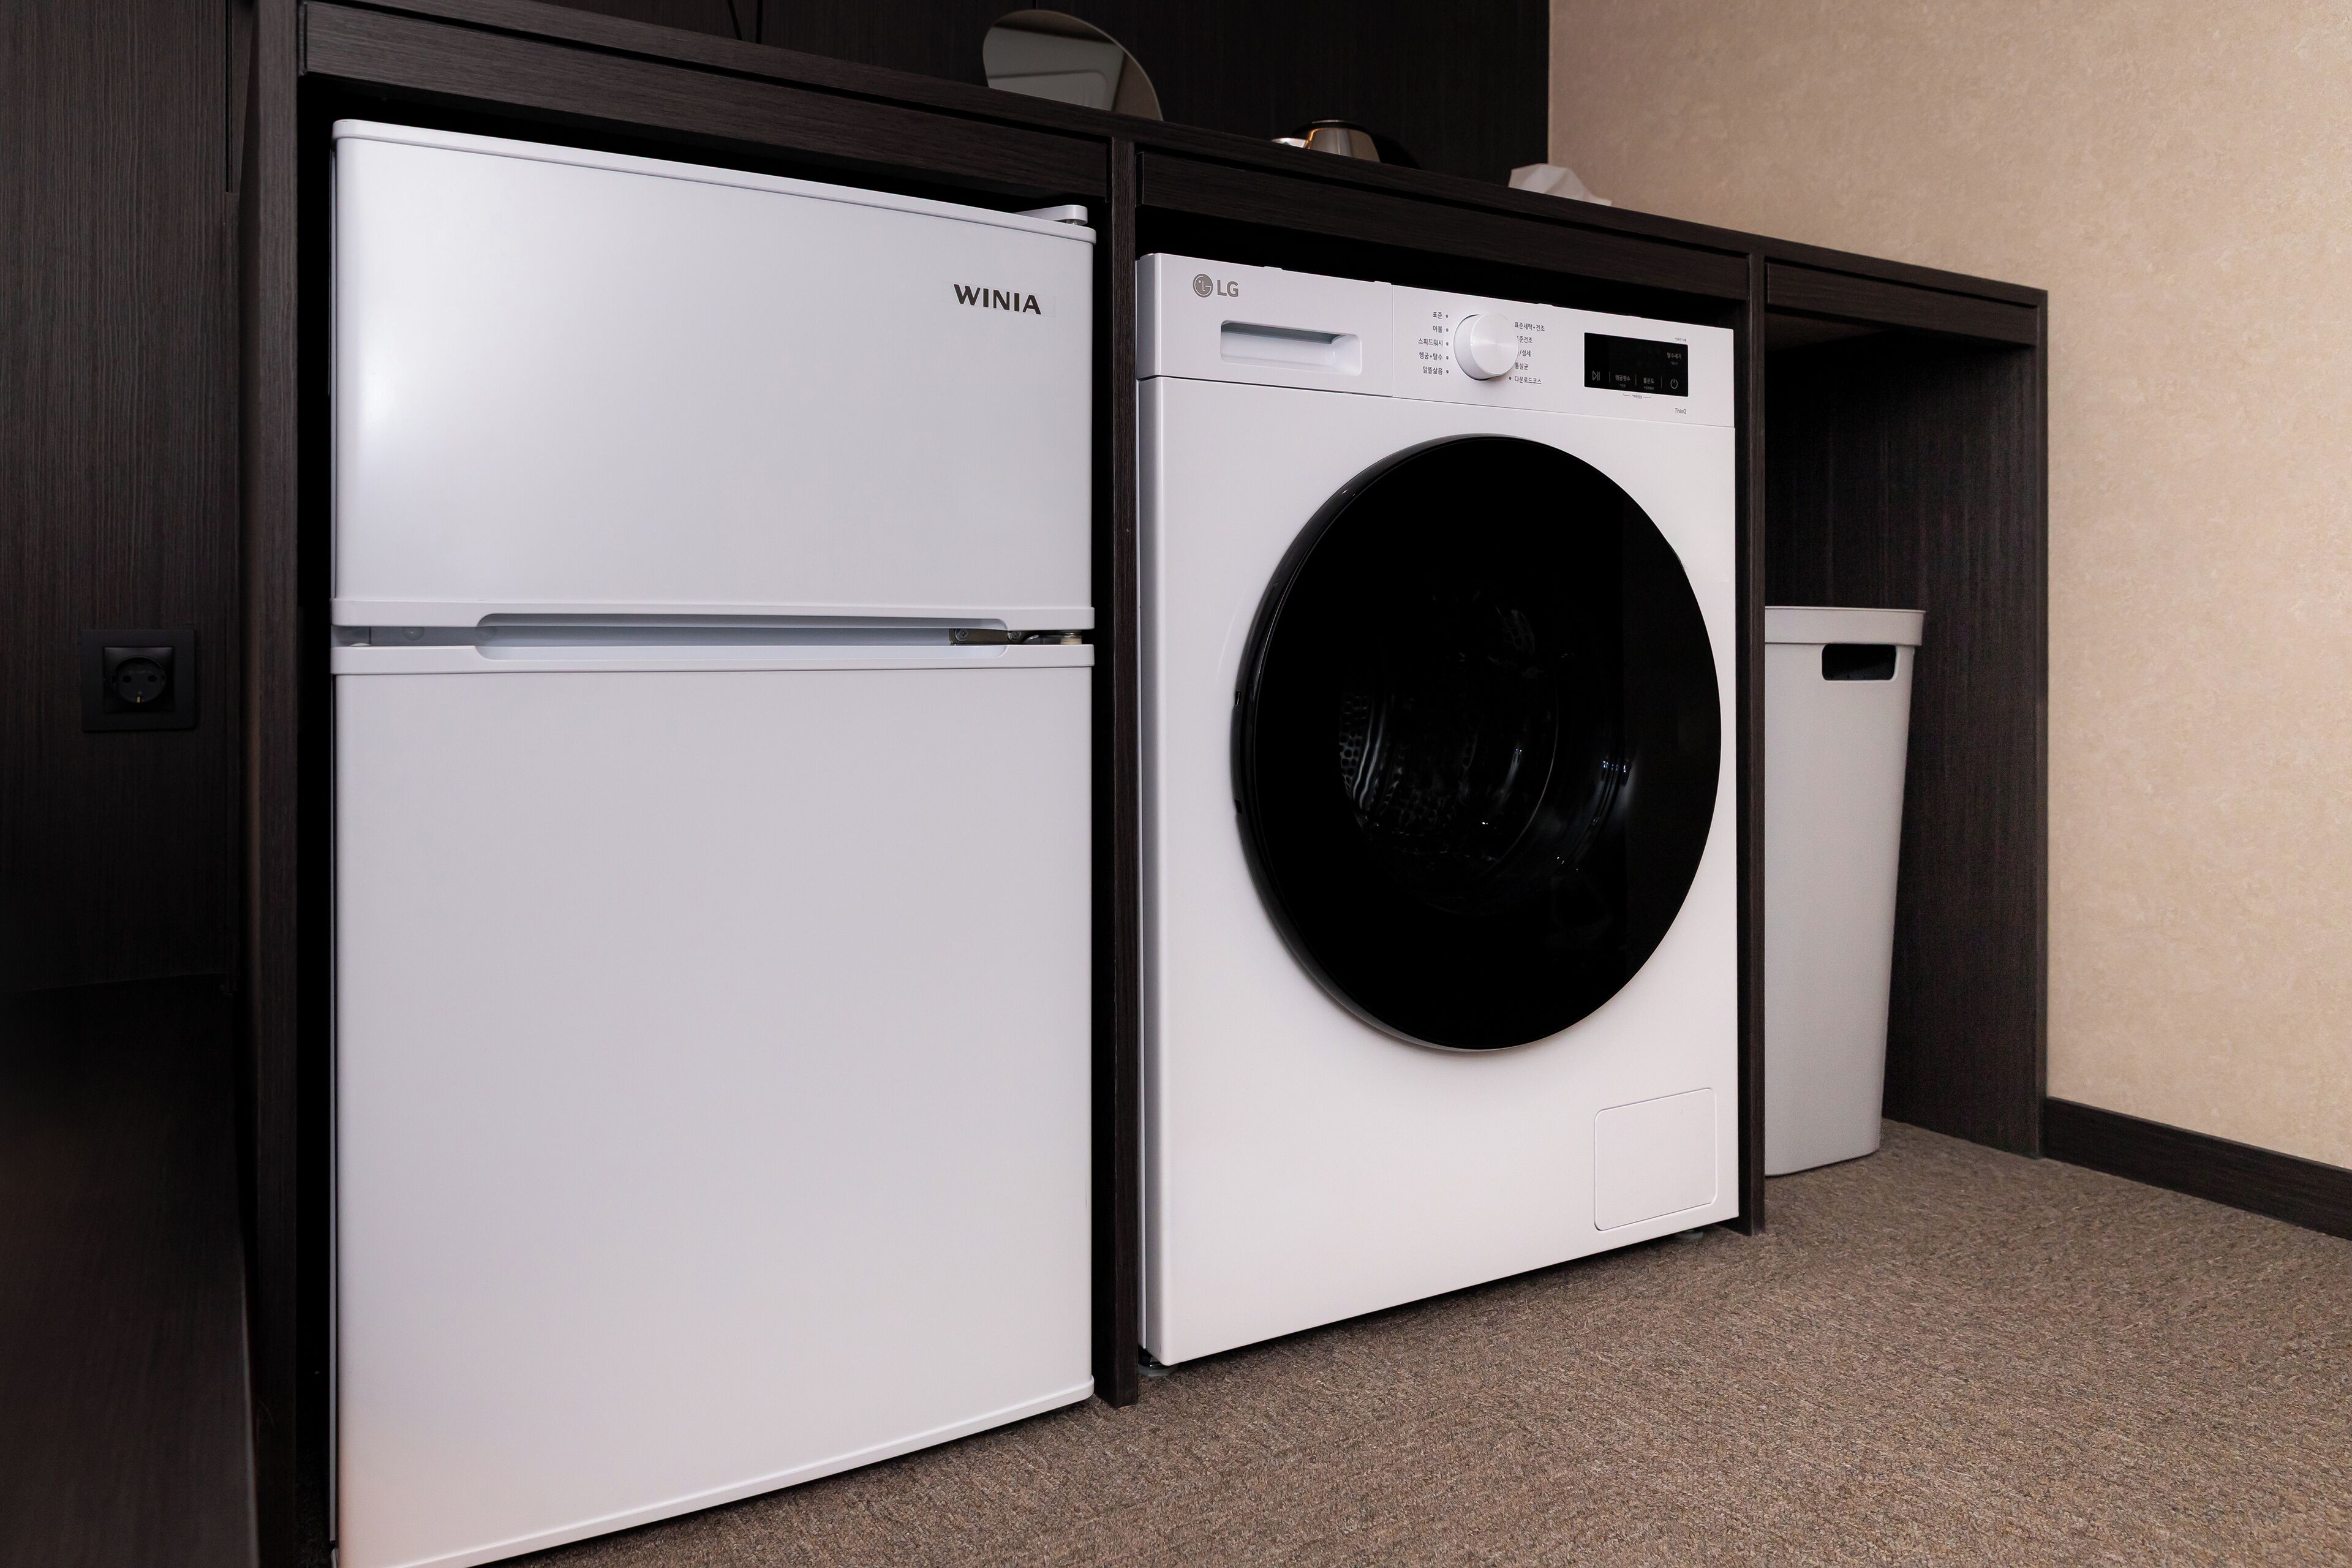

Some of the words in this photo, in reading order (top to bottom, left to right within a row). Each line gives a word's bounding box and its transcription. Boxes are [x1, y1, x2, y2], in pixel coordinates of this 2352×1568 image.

[1217, 279, 1239, 298] LG
[954, 284, 1041, 315] WINIA
[1515, 322, 1545, 331] 표준세탁+건조
[1418, 337, 1443, 347] 스피드워시
[1419, 352, 1442, 361] 헹굼+탈수
[1422, 366, 1442, 375] 알뜰삶음
[1515, 362, 1528, 371] 통살균
